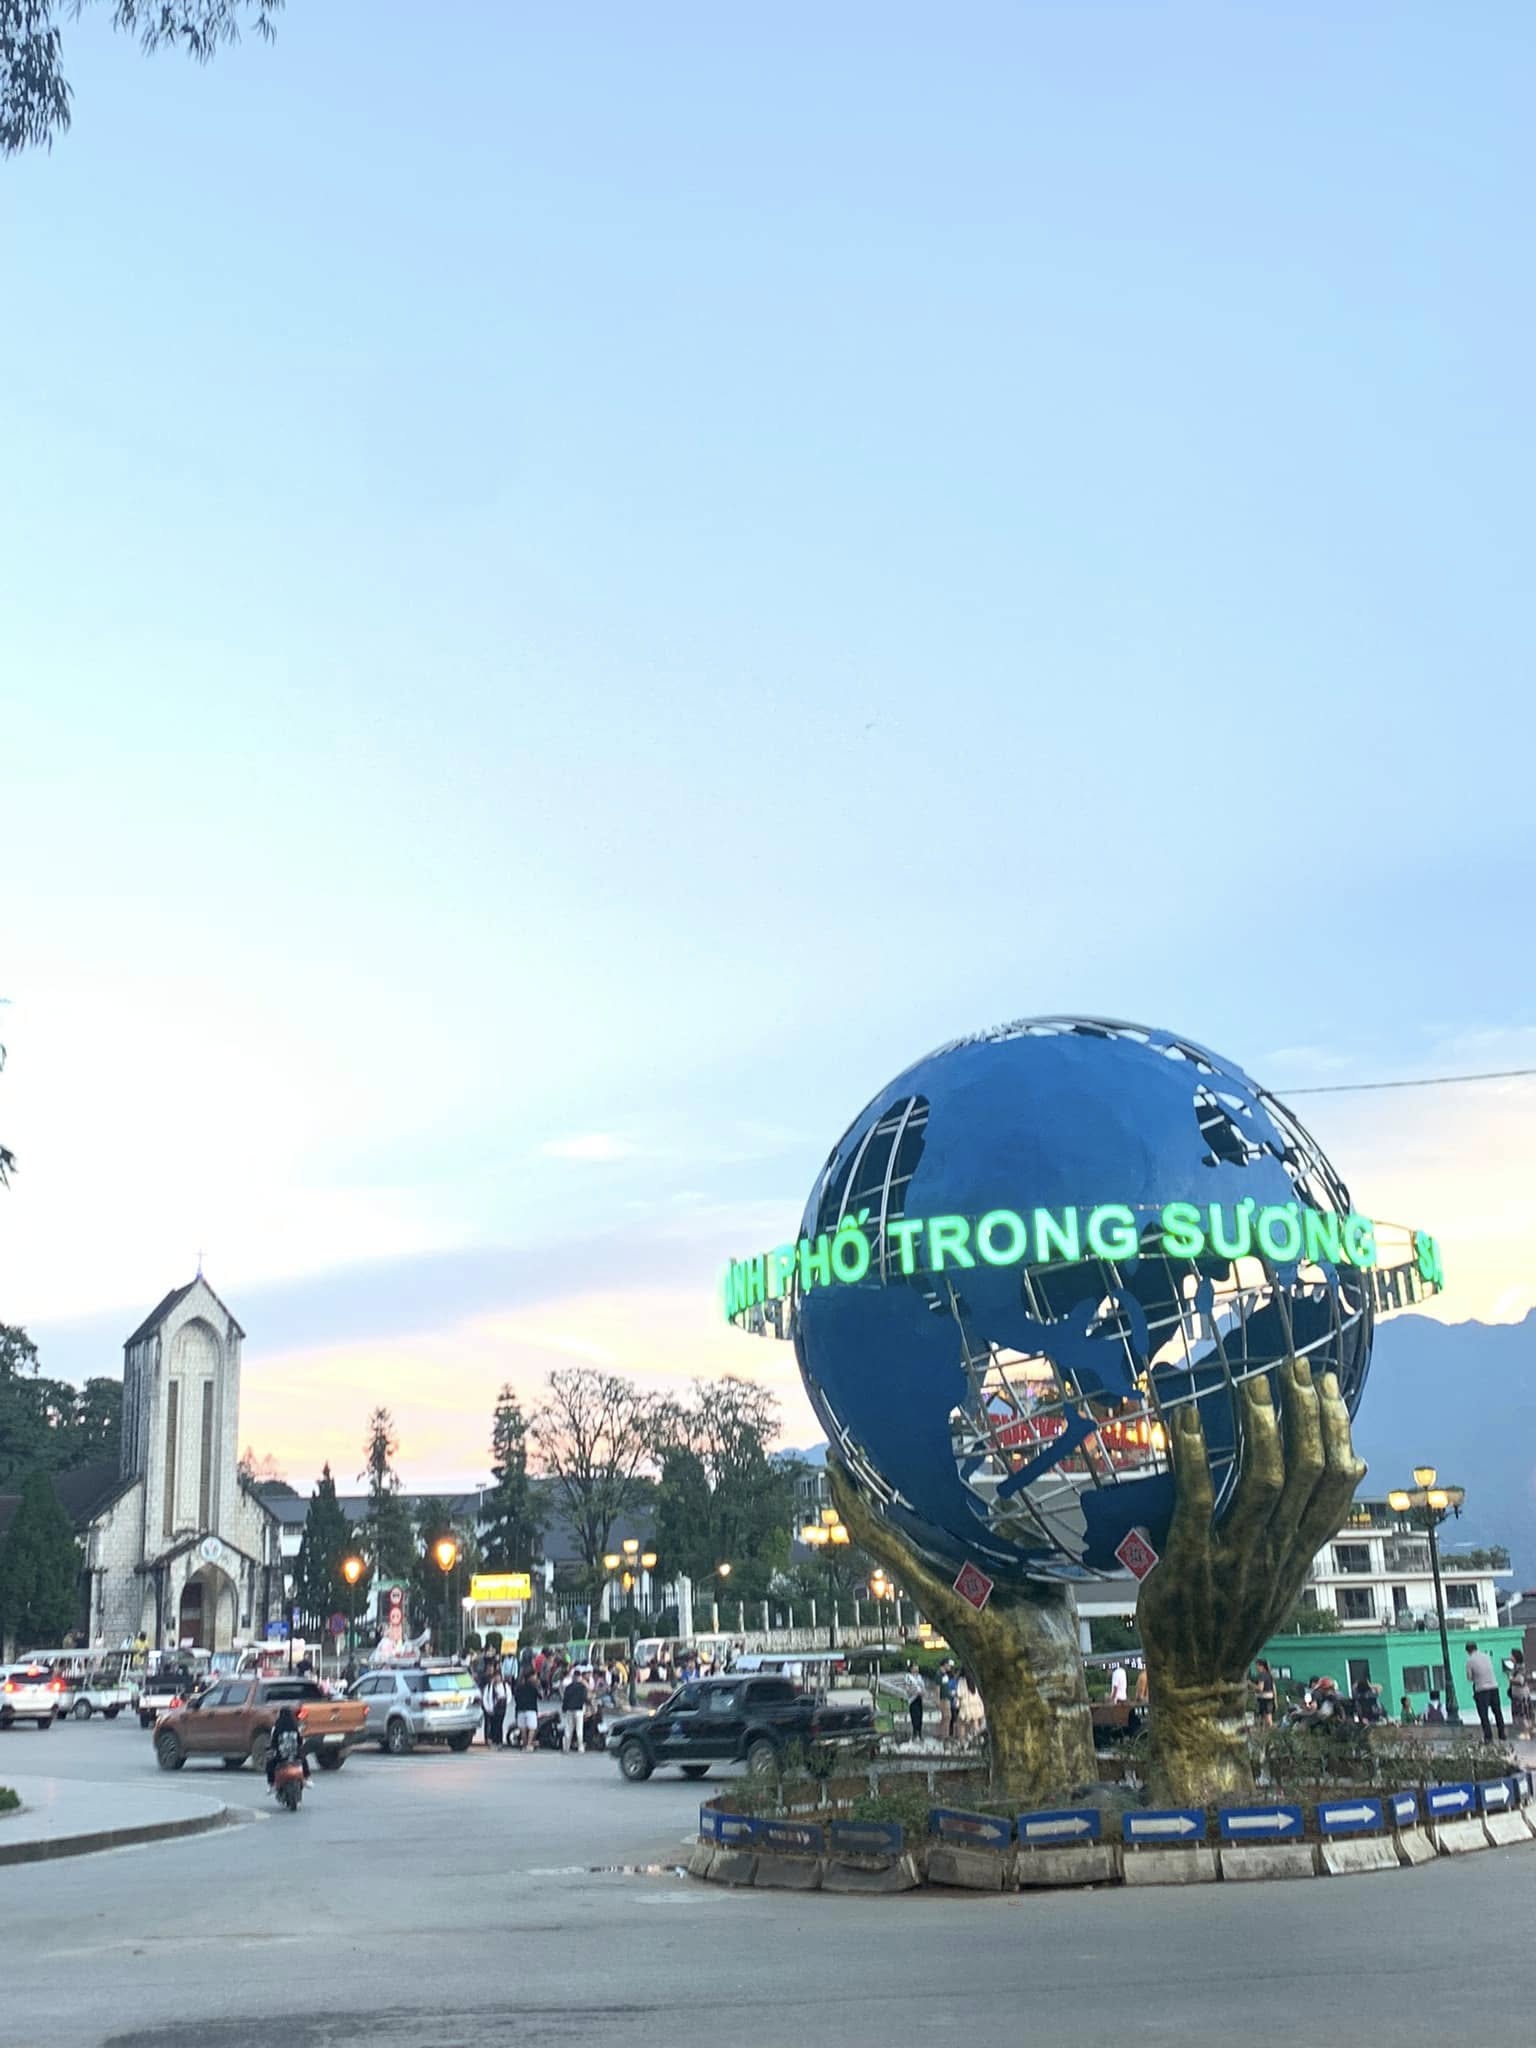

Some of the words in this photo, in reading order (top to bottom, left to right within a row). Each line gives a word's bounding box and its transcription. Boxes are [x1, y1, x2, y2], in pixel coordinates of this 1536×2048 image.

[775, 1207, 870, 1297] PHỐ
[887, 1204, 1139, 1274] TRONG
[1162, 1197, 1376, 1267] SƯƠNG
